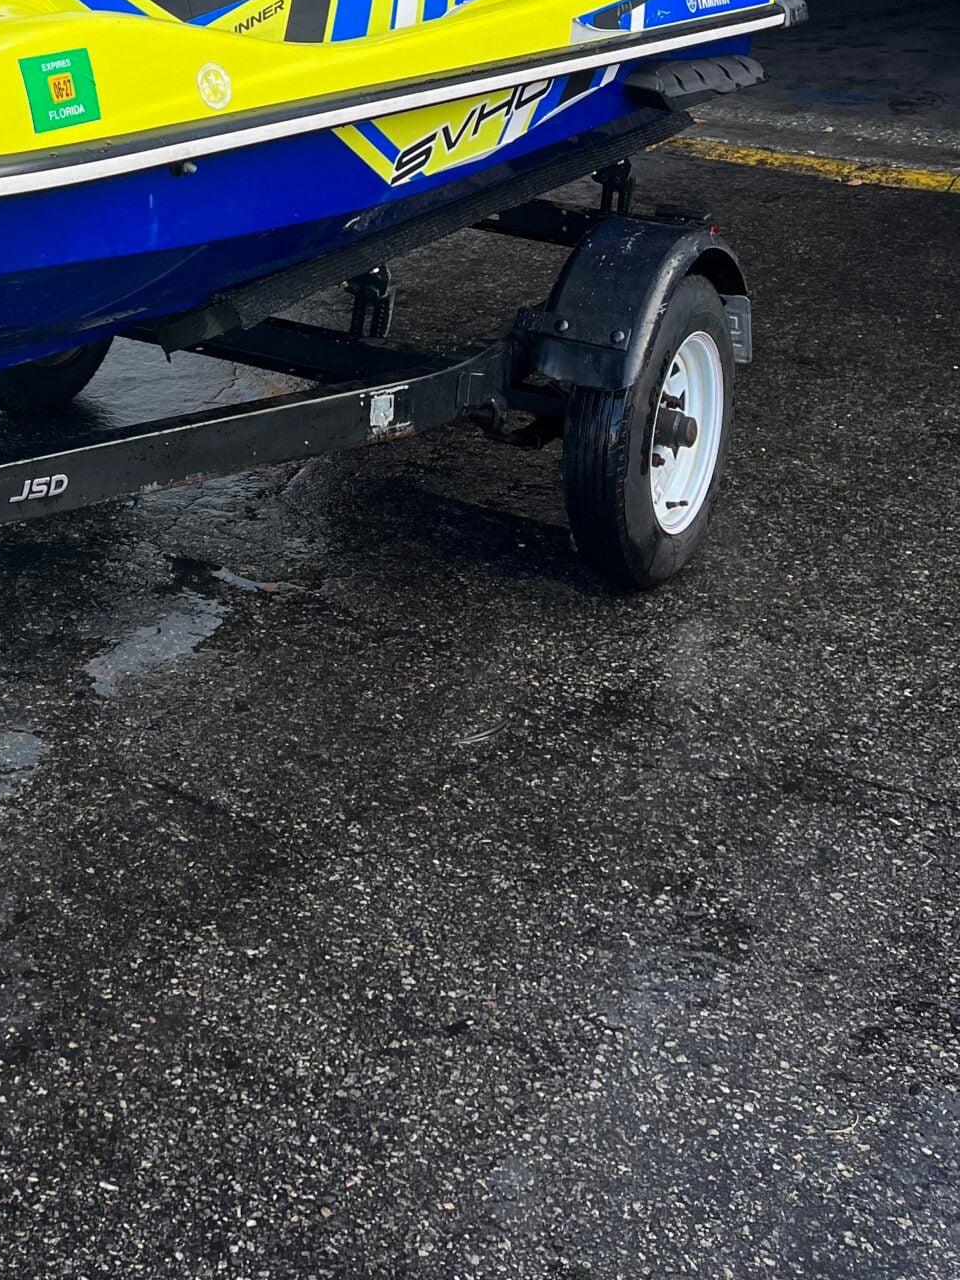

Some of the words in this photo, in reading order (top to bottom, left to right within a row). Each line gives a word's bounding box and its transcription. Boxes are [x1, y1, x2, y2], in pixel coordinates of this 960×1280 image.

[41, 58, 71, 72] EXPIRES
[49, 103, 86, 121] FLORIDA
[390, 79, 552, 185] SVHO
[9, 473, 69, 503] JSD
